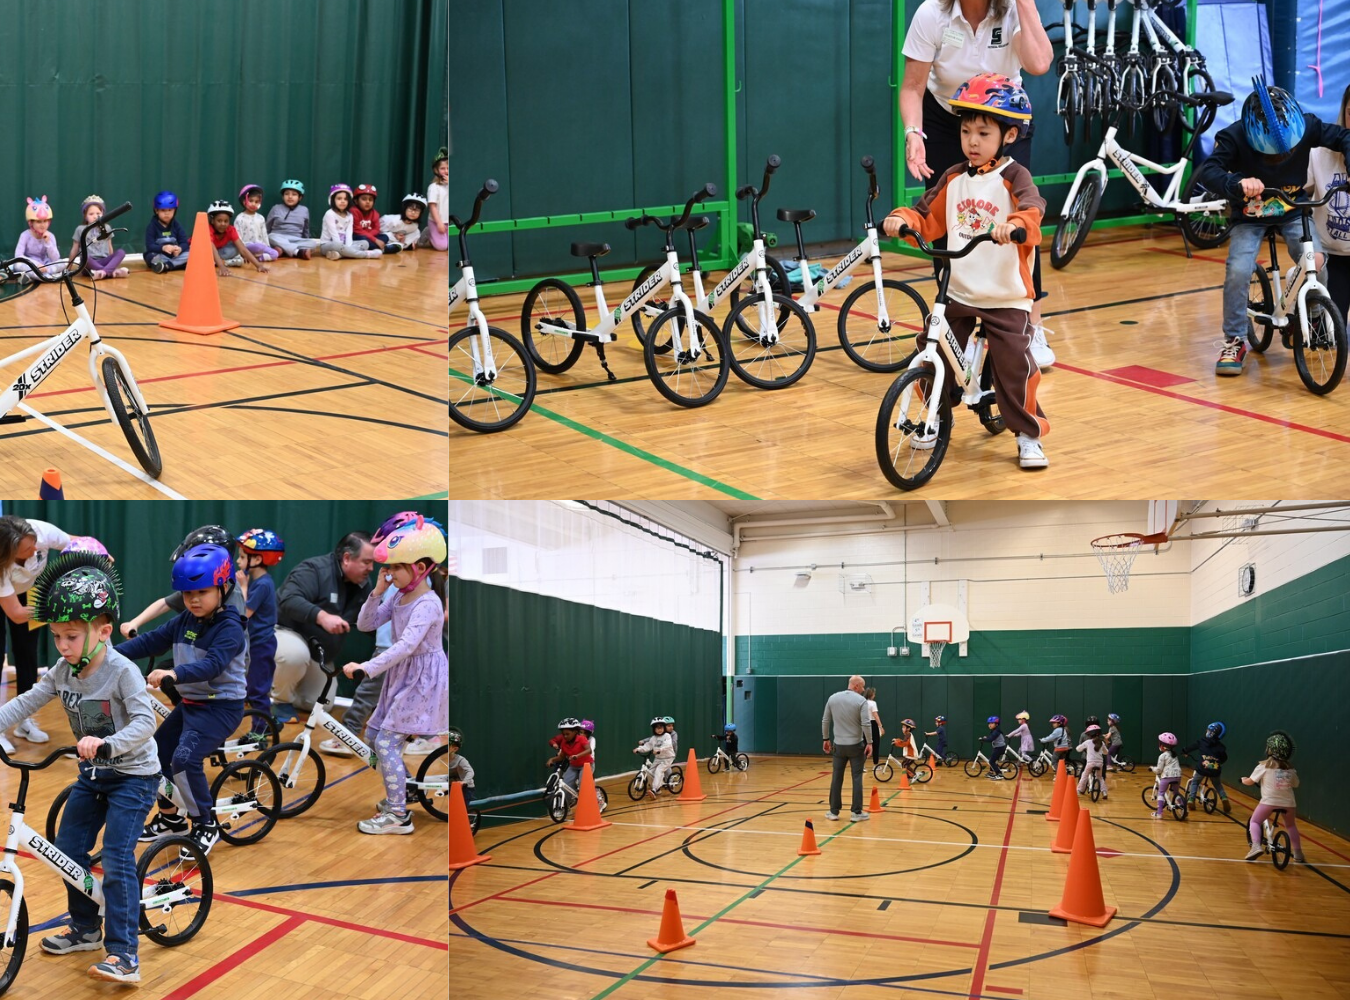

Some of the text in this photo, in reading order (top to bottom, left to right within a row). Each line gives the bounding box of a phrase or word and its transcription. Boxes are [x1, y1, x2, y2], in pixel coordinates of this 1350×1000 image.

[715, 257, 750, 297] STRIDER
[826, 246, 863, 284] STRIDER
[623, 270, 663, 312] STRIDER
[30, 328, 82, 383] STRIDER
[945, 328, 967, 371] STRIDER
[323, 721, 369, 758] STRIDER
[28, 835, 84, 881] STRIDER
